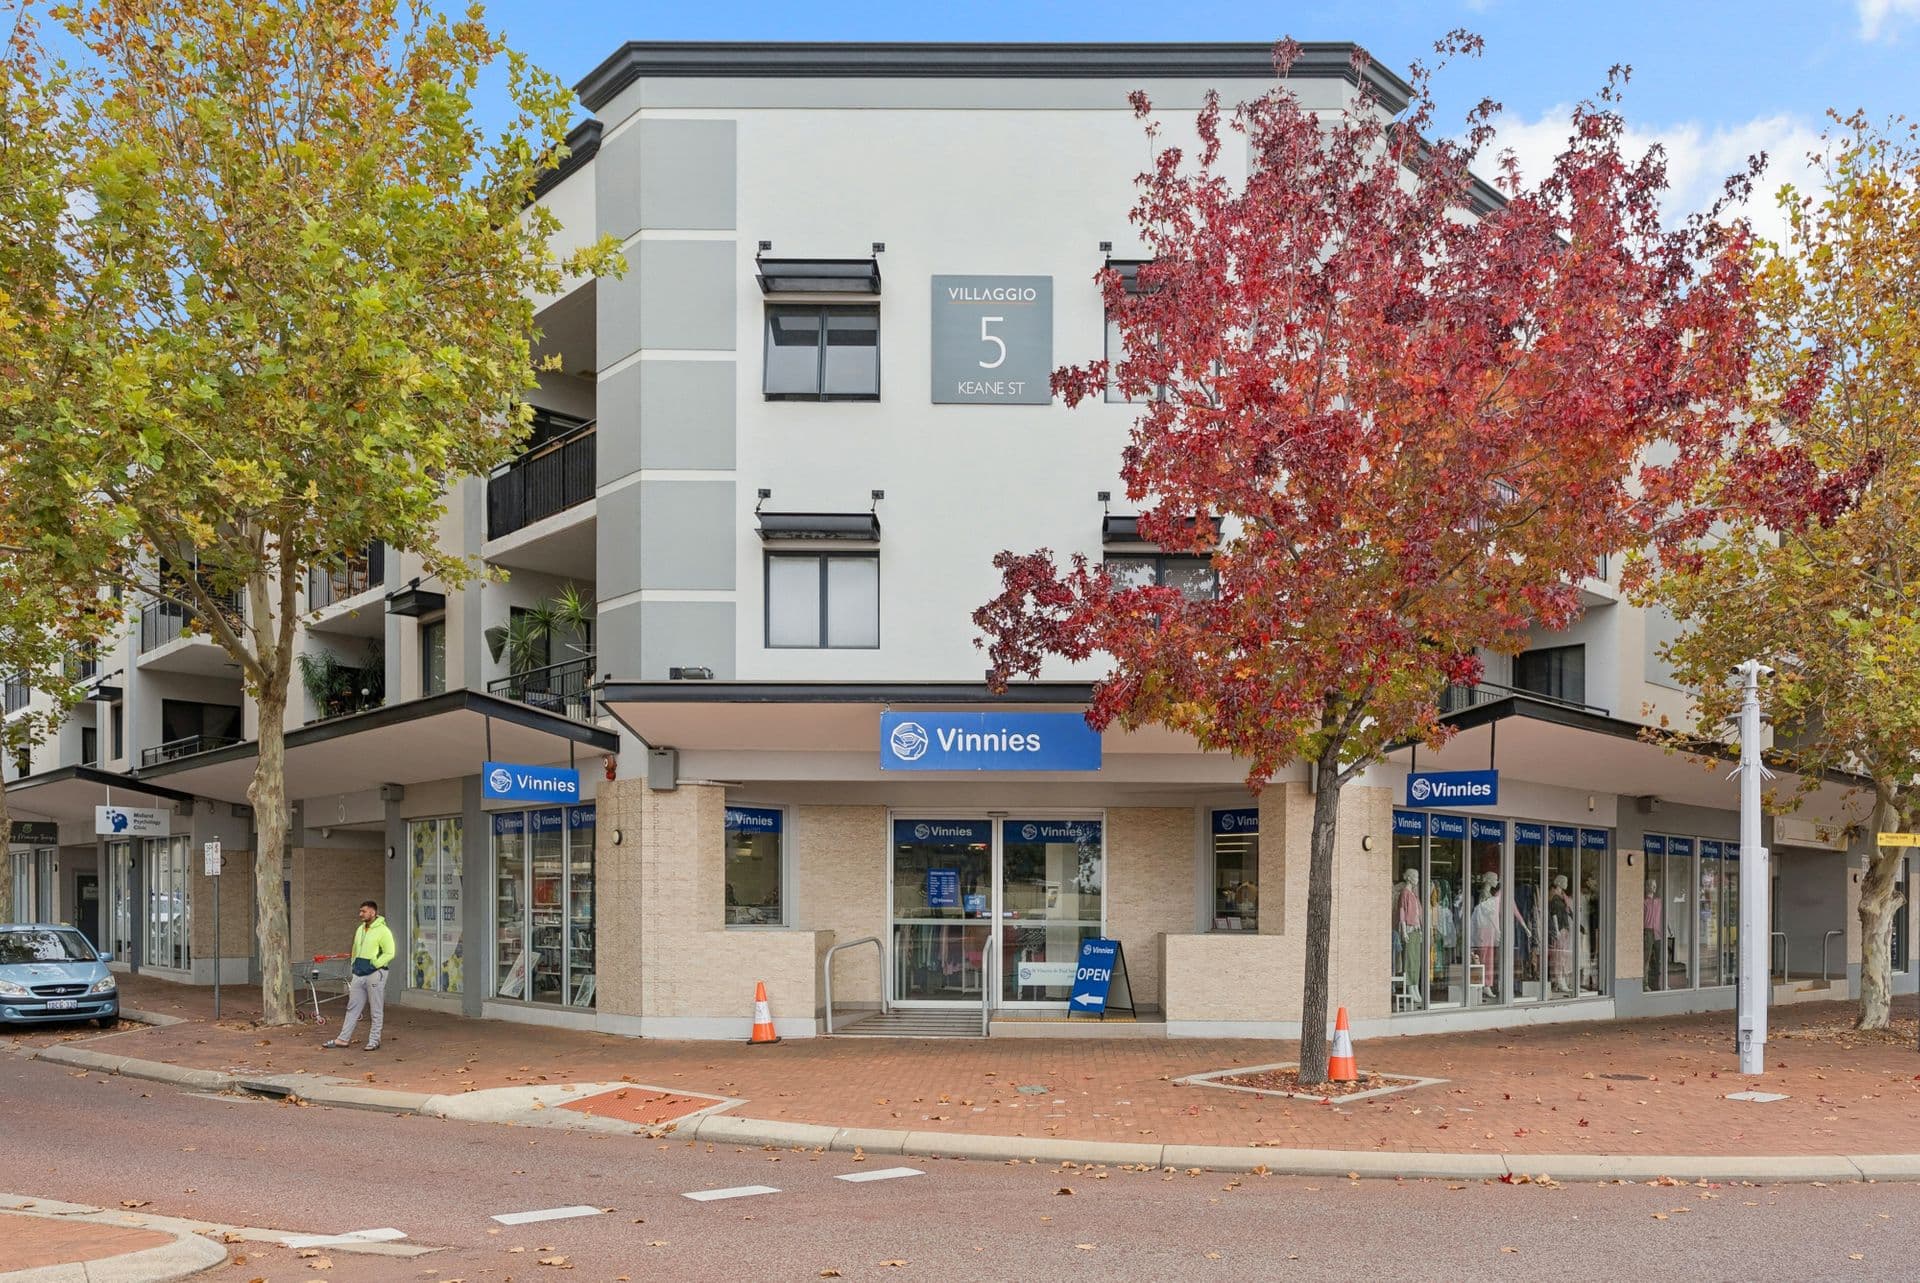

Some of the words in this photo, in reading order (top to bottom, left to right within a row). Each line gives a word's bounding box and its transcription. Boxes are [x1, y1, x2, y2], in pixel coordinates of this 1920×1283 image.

[948, 287, 1037, 301] VILLAGGIO
[978, 316, 1007, 369] 5
[958, 381, 1005, 395] KEANE
[1008, 381, 1026, 395] ST
[936, 727, 1041, 752] Vinnies
[516, 774, 576, 793] Vinnies
[1431, 781, 1491, 797] Vinnies
[580, 811, 595, 822] Vinn
[735, 813, 774, 826] Vinnies
[1236, 815, 1259, 826] Vinn
[1398, 817, 1422, 829] Vinnies
[1440, 821, 1463, 833] Vinnies
[931, 826, 972, 837] Vinnies
[1040, 826, 1083, 837] Vinnies
[1480, 825, 1501, 837] Vinnies
[1521, 829, 1541, 840] Vinnies
[1555, 832, 1574, 843] Vinnies
[1092, 946, 1114, 954] Vinnies
[1077, 967, 1111, 982] OPEN
